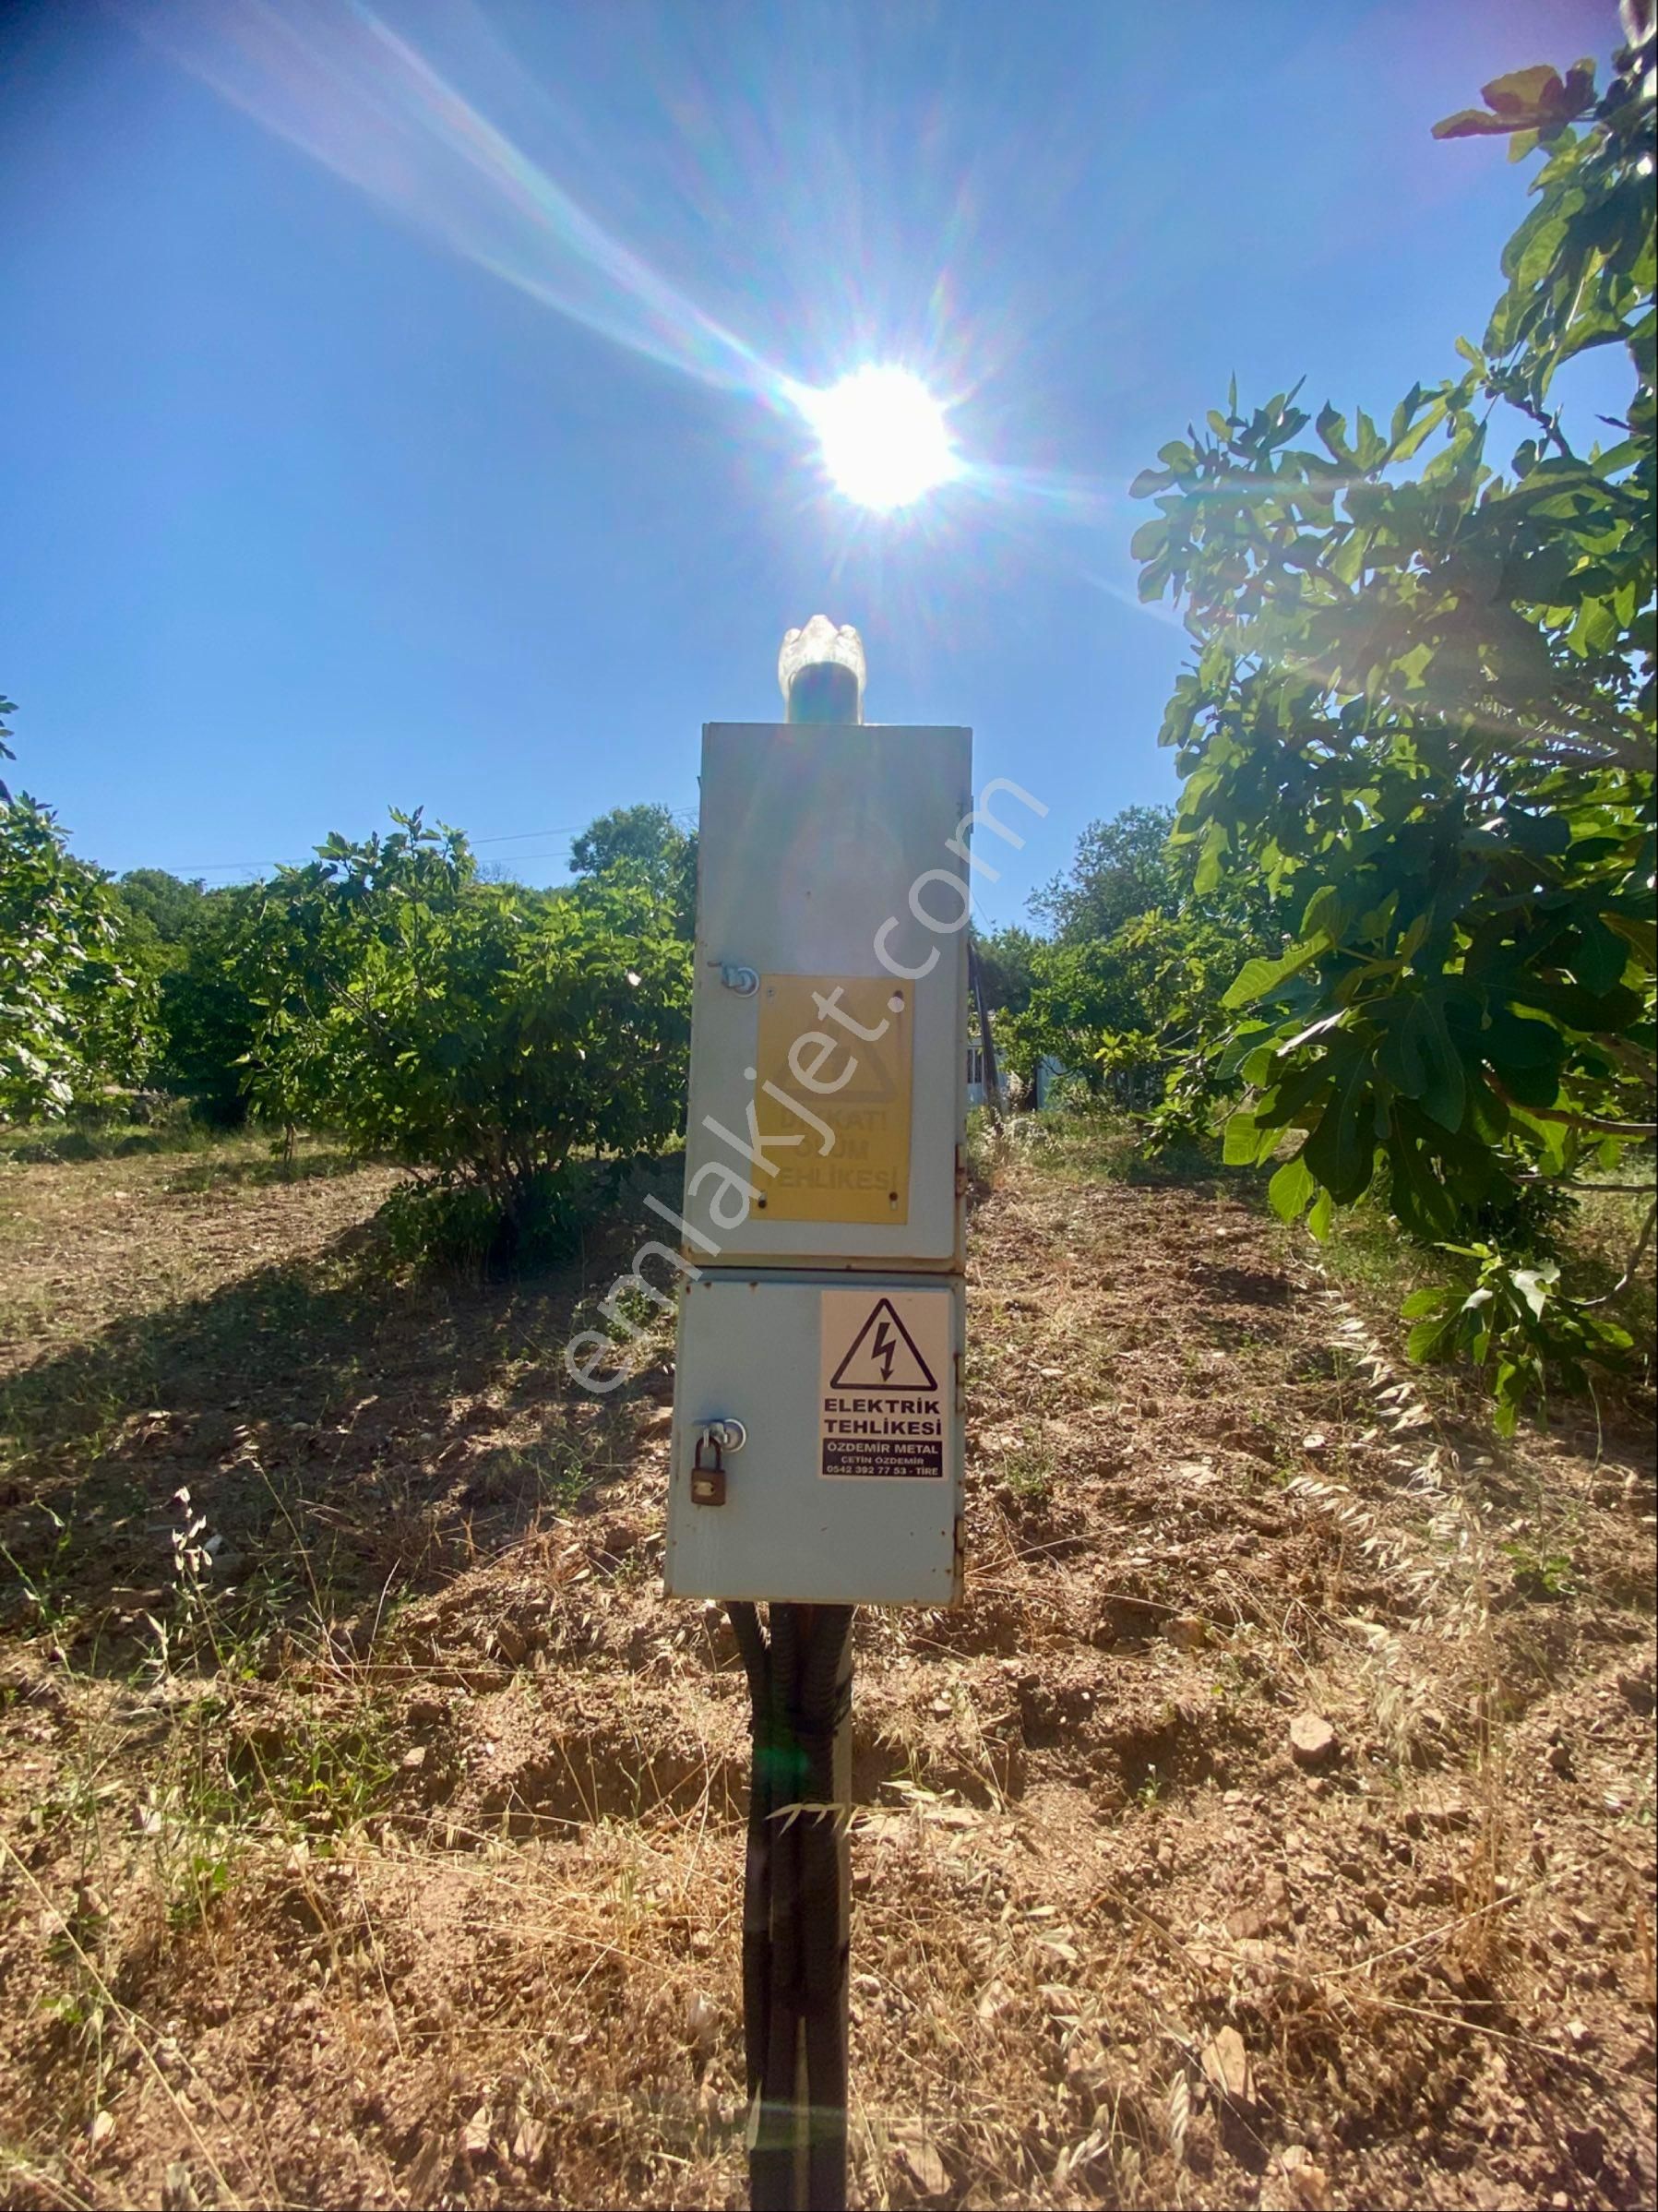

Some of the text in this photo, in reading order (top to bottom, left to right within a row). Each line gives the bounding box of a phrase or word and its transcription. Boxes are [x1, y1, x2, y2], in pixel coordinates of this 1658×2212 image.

[781, 1107, 886, 1130] DKAT!
[824, 1397, 940, 1414] ELEKTRİK
[824, 1417, 941, 1436] TEHLİKESİ
[827, 1441, 938, 1454] ÖZDEMİR METAL
[875, 1455, 924, 1465] ÖZDEMİR
[827, 1465, 852, 1474] 0542
[877, 1466, 890, 1475] 77
[915, 1465, 938, 1476] TİRE
